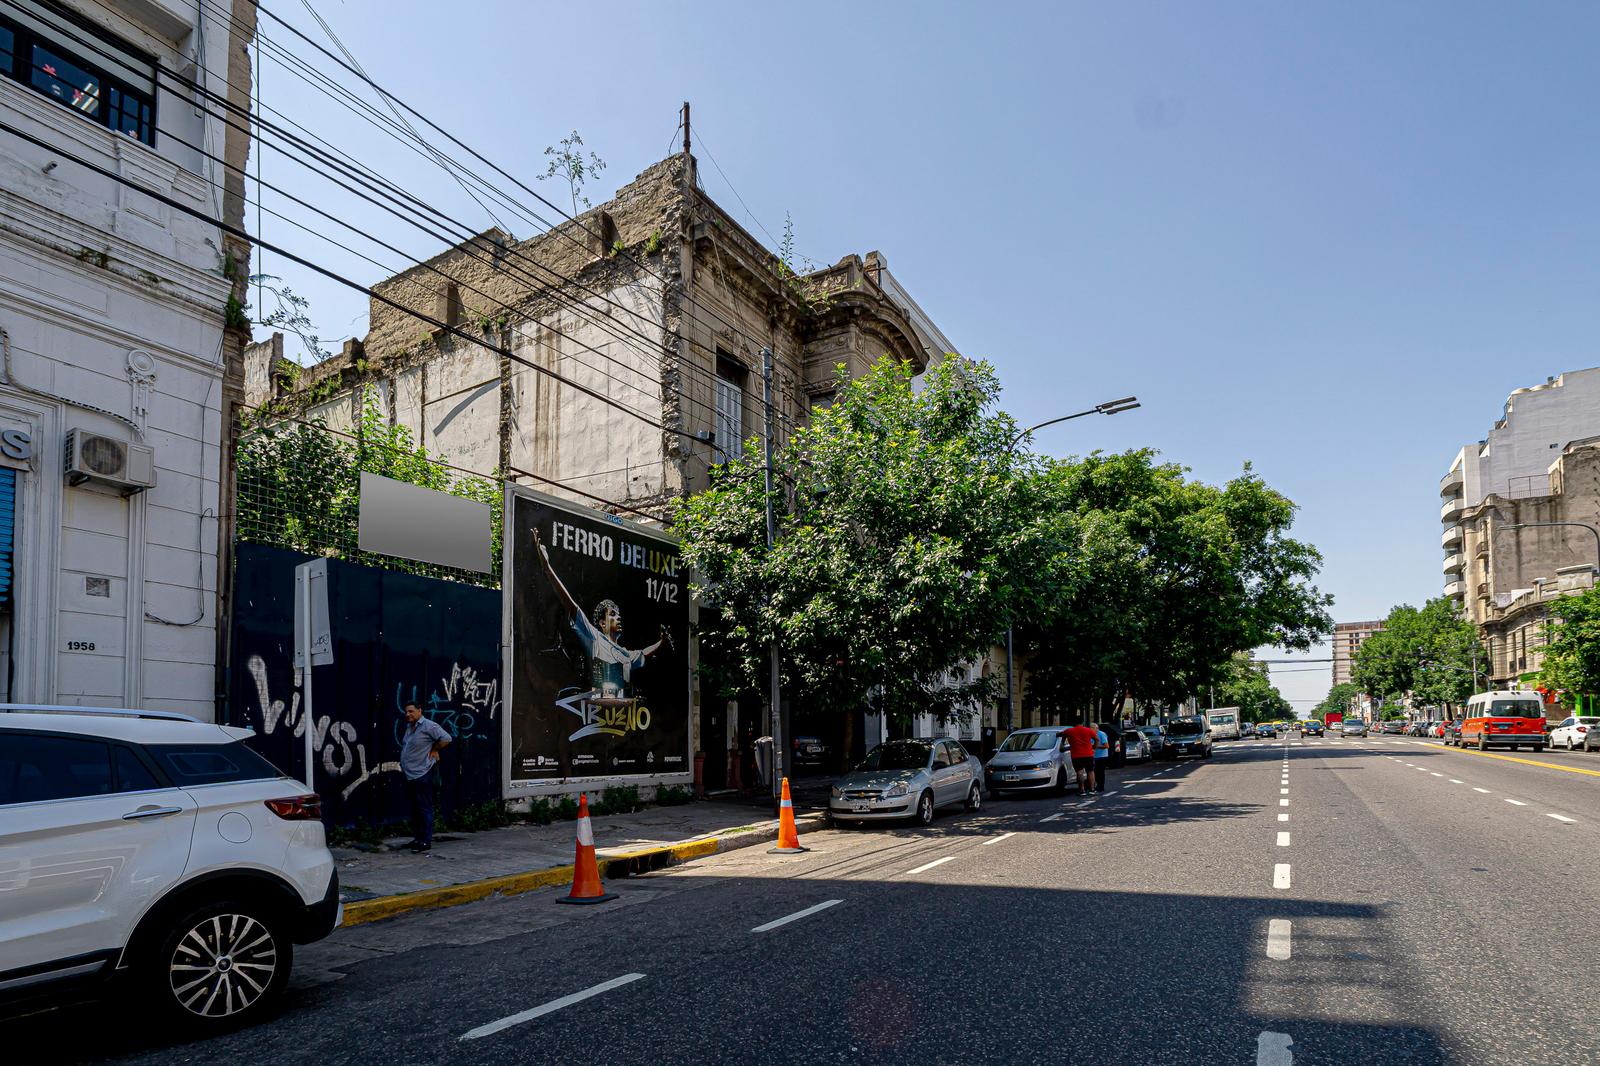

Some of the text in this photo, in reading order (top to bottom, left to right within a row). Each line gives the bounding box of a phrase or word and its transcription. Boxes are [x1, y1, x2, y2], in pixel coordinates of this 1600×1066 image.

[552, 521, 679, 578] FERRO DELUXE
[646, 577, 678, 604] 11/12
[67, 640, 95, 651] 1958
